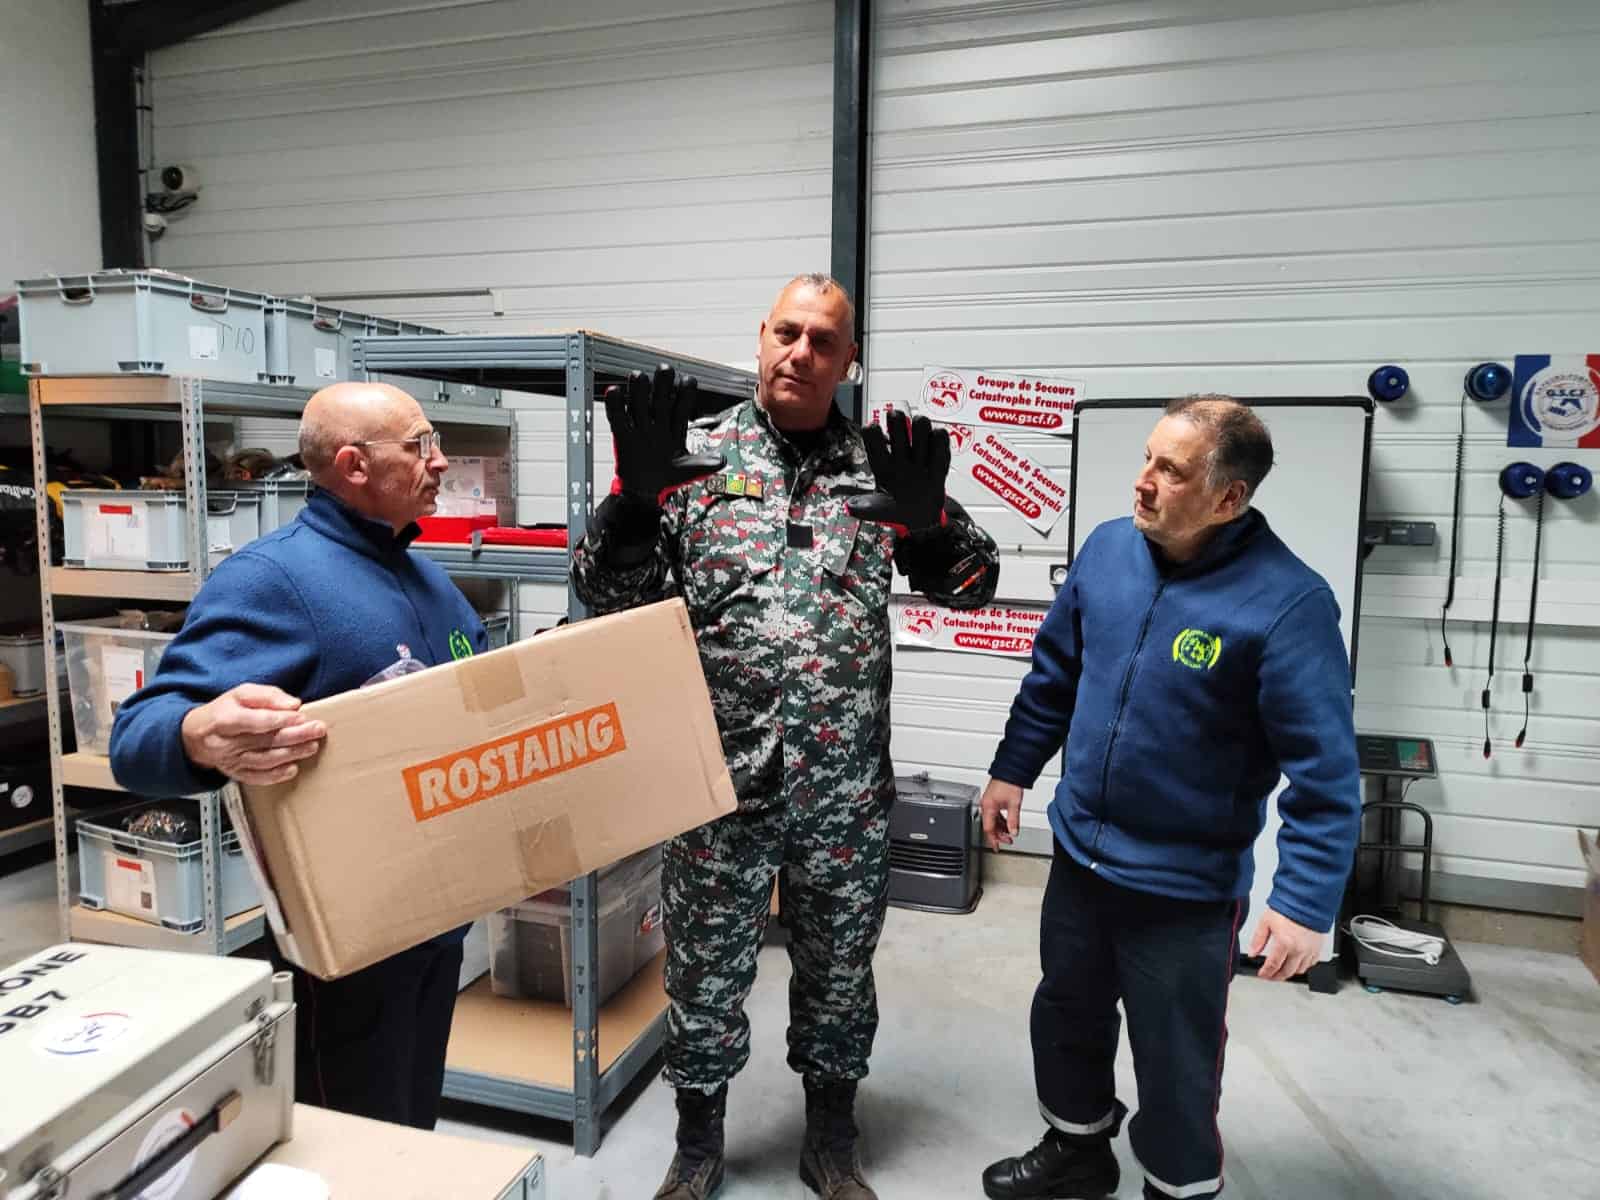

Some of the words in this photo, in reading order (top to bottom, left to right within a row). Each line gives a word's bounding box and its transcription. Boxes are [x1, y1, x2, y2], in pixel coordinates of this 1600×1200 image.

[977, 375, 1015, 391] Groupe
[1018, 379, 1031, 391] de
[1034, 381, 1075, 396] Secours
[969, 389, 1031, 407] Catastrophe
[1035, 396, 1074, 412] Françai
[983, 409, 1058, 426] www.gscf.fr
[972, 442, 1025, 484] Catastrophe
[1025, 481, 1062, 512] Français
[986, 434, 1018, 462] Groupe
[1019, 459, 1031, 472] de
[1032, 468, 1066, 497] Secours
[976, 467, 1037, 513] www.gscf.fr
[990, 608, 1003, 618] de
[1006, 609, 1044, 621] Secours
[943, 617, 1003, 633] Catastrophe
[1007, 623, 1039, 637] Franç
[958, 635, 1030, 649] www.gscf.fr
[418, 712, 614, 812] ROSTAING
[0, 951, 88, 996] ONE
